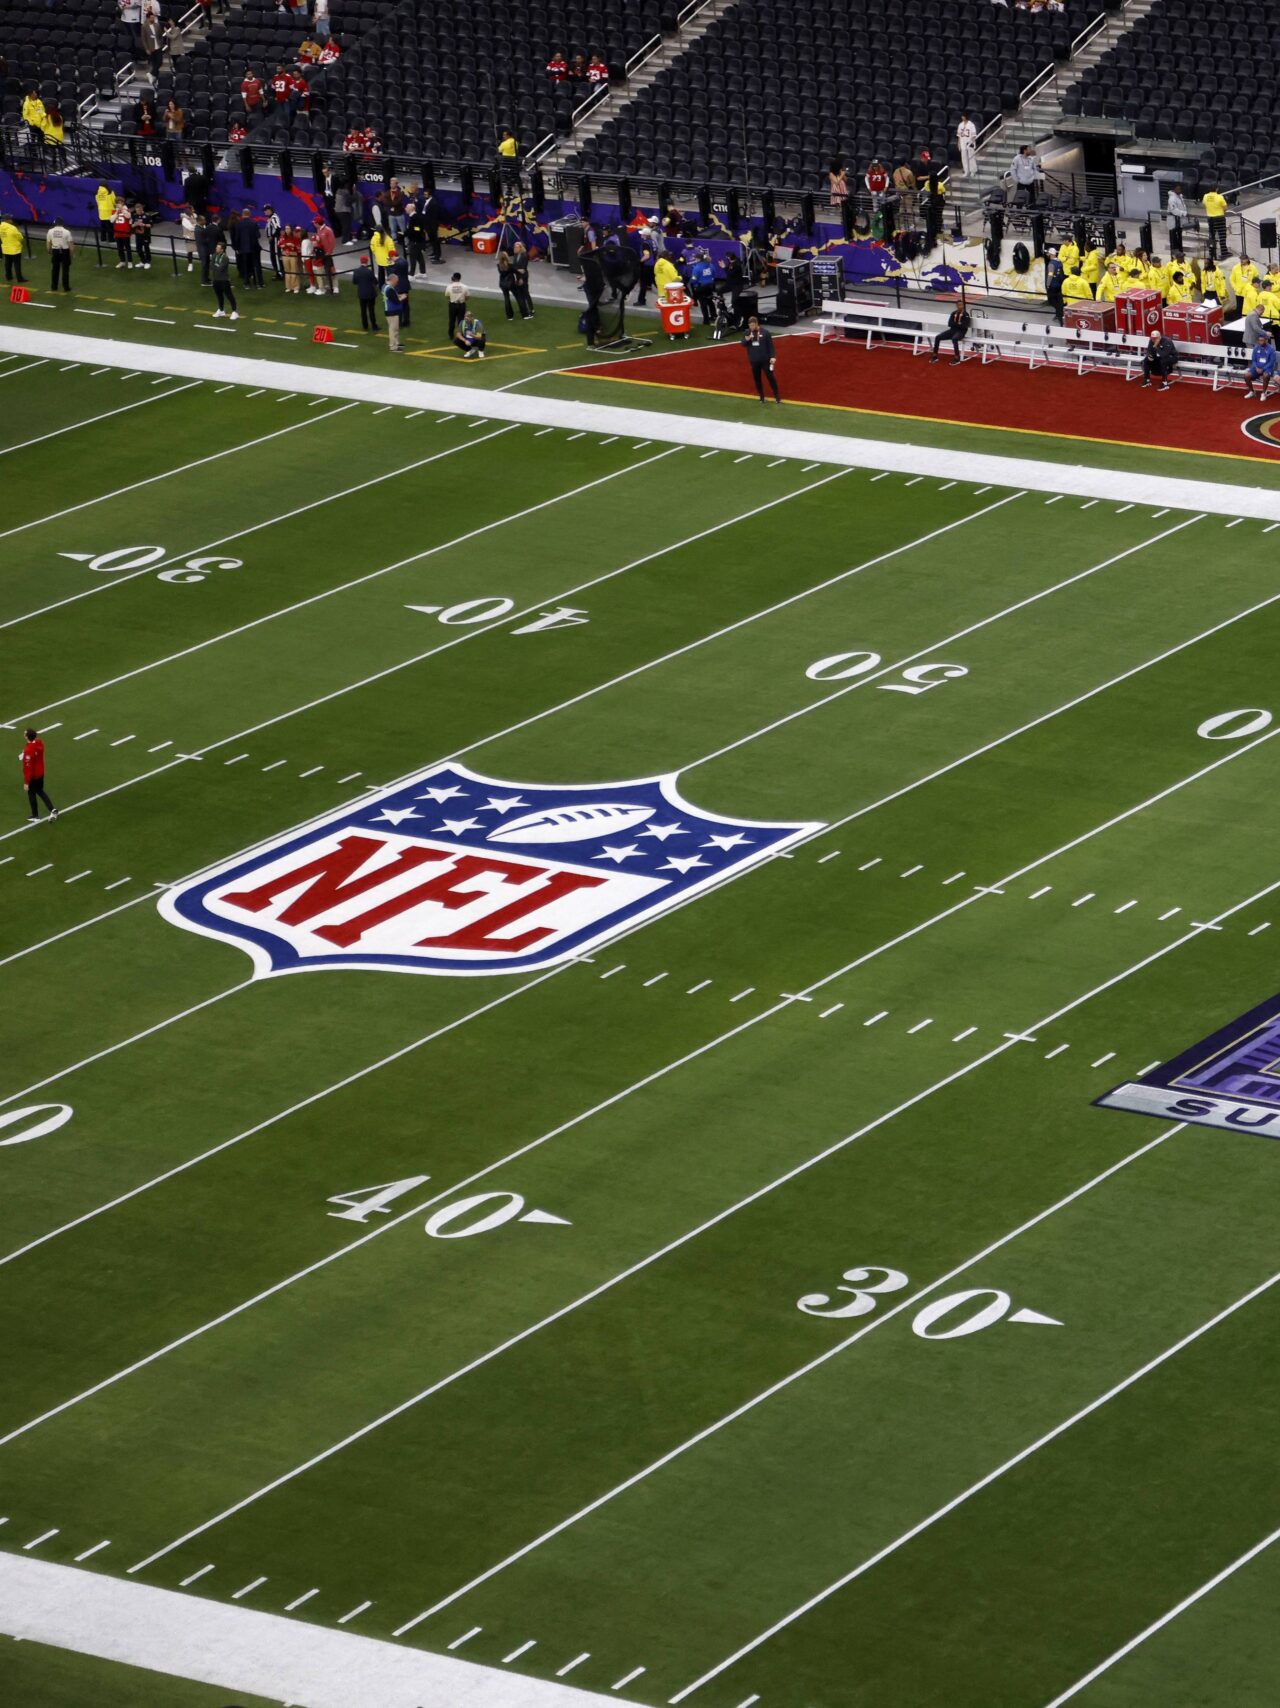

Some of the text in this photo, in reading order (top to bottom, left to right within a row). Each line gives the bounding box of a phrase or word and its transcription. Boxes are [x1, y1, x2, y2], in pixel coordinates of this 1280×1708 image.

[364, 173, 384, 182] C109
[12, 287, 23, 301] 10
[313, 328, 326, 341] 20
[669, 310, 684, 326] G
[437, 597, 590, 635] 40
[805, 651, 969, 695] 50
[219, 836, 611, 952] NFL
[326, 1175, 525, 1239] 40
[796, 1266, 1012, 1340] 30
